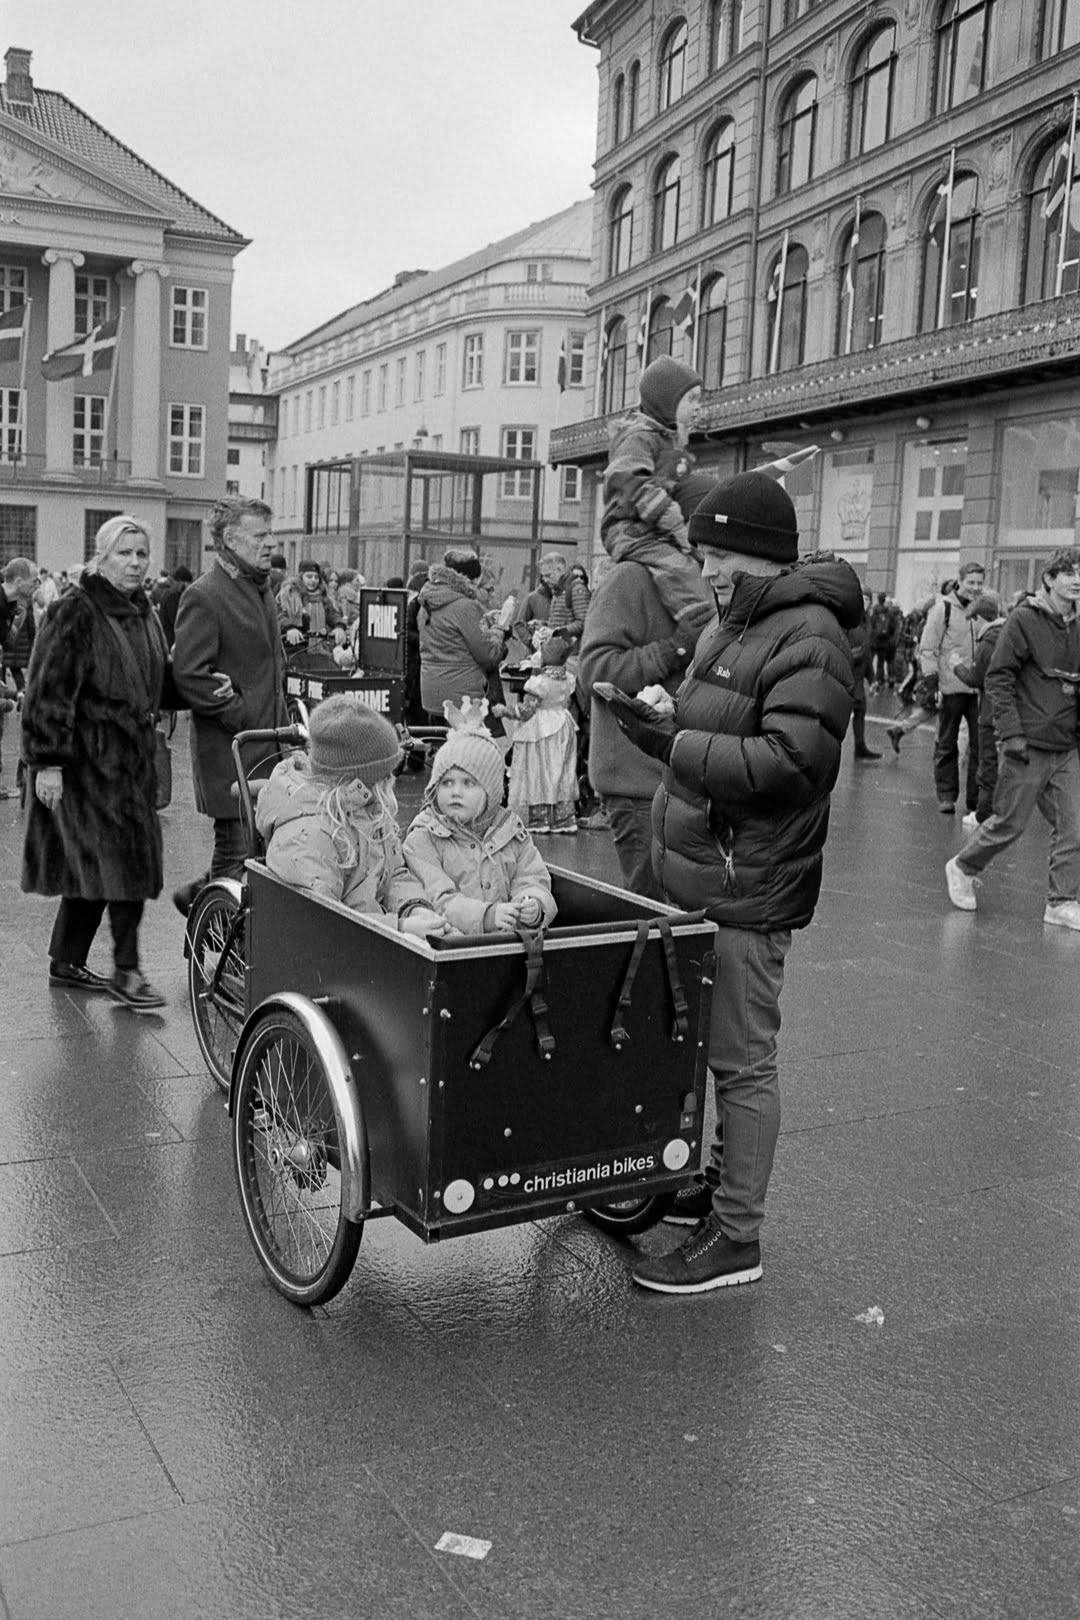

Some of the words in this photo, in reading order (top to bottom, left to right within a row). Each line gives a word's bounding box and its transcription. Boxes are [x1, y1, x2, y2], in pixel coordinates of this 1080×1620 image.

[367, 604, 398, 640] PRIME
[716, 666, 731, 679] Rab
[523, 1163, 610, 1193] christiania
[613, 1155, 654, 1175] bikes
